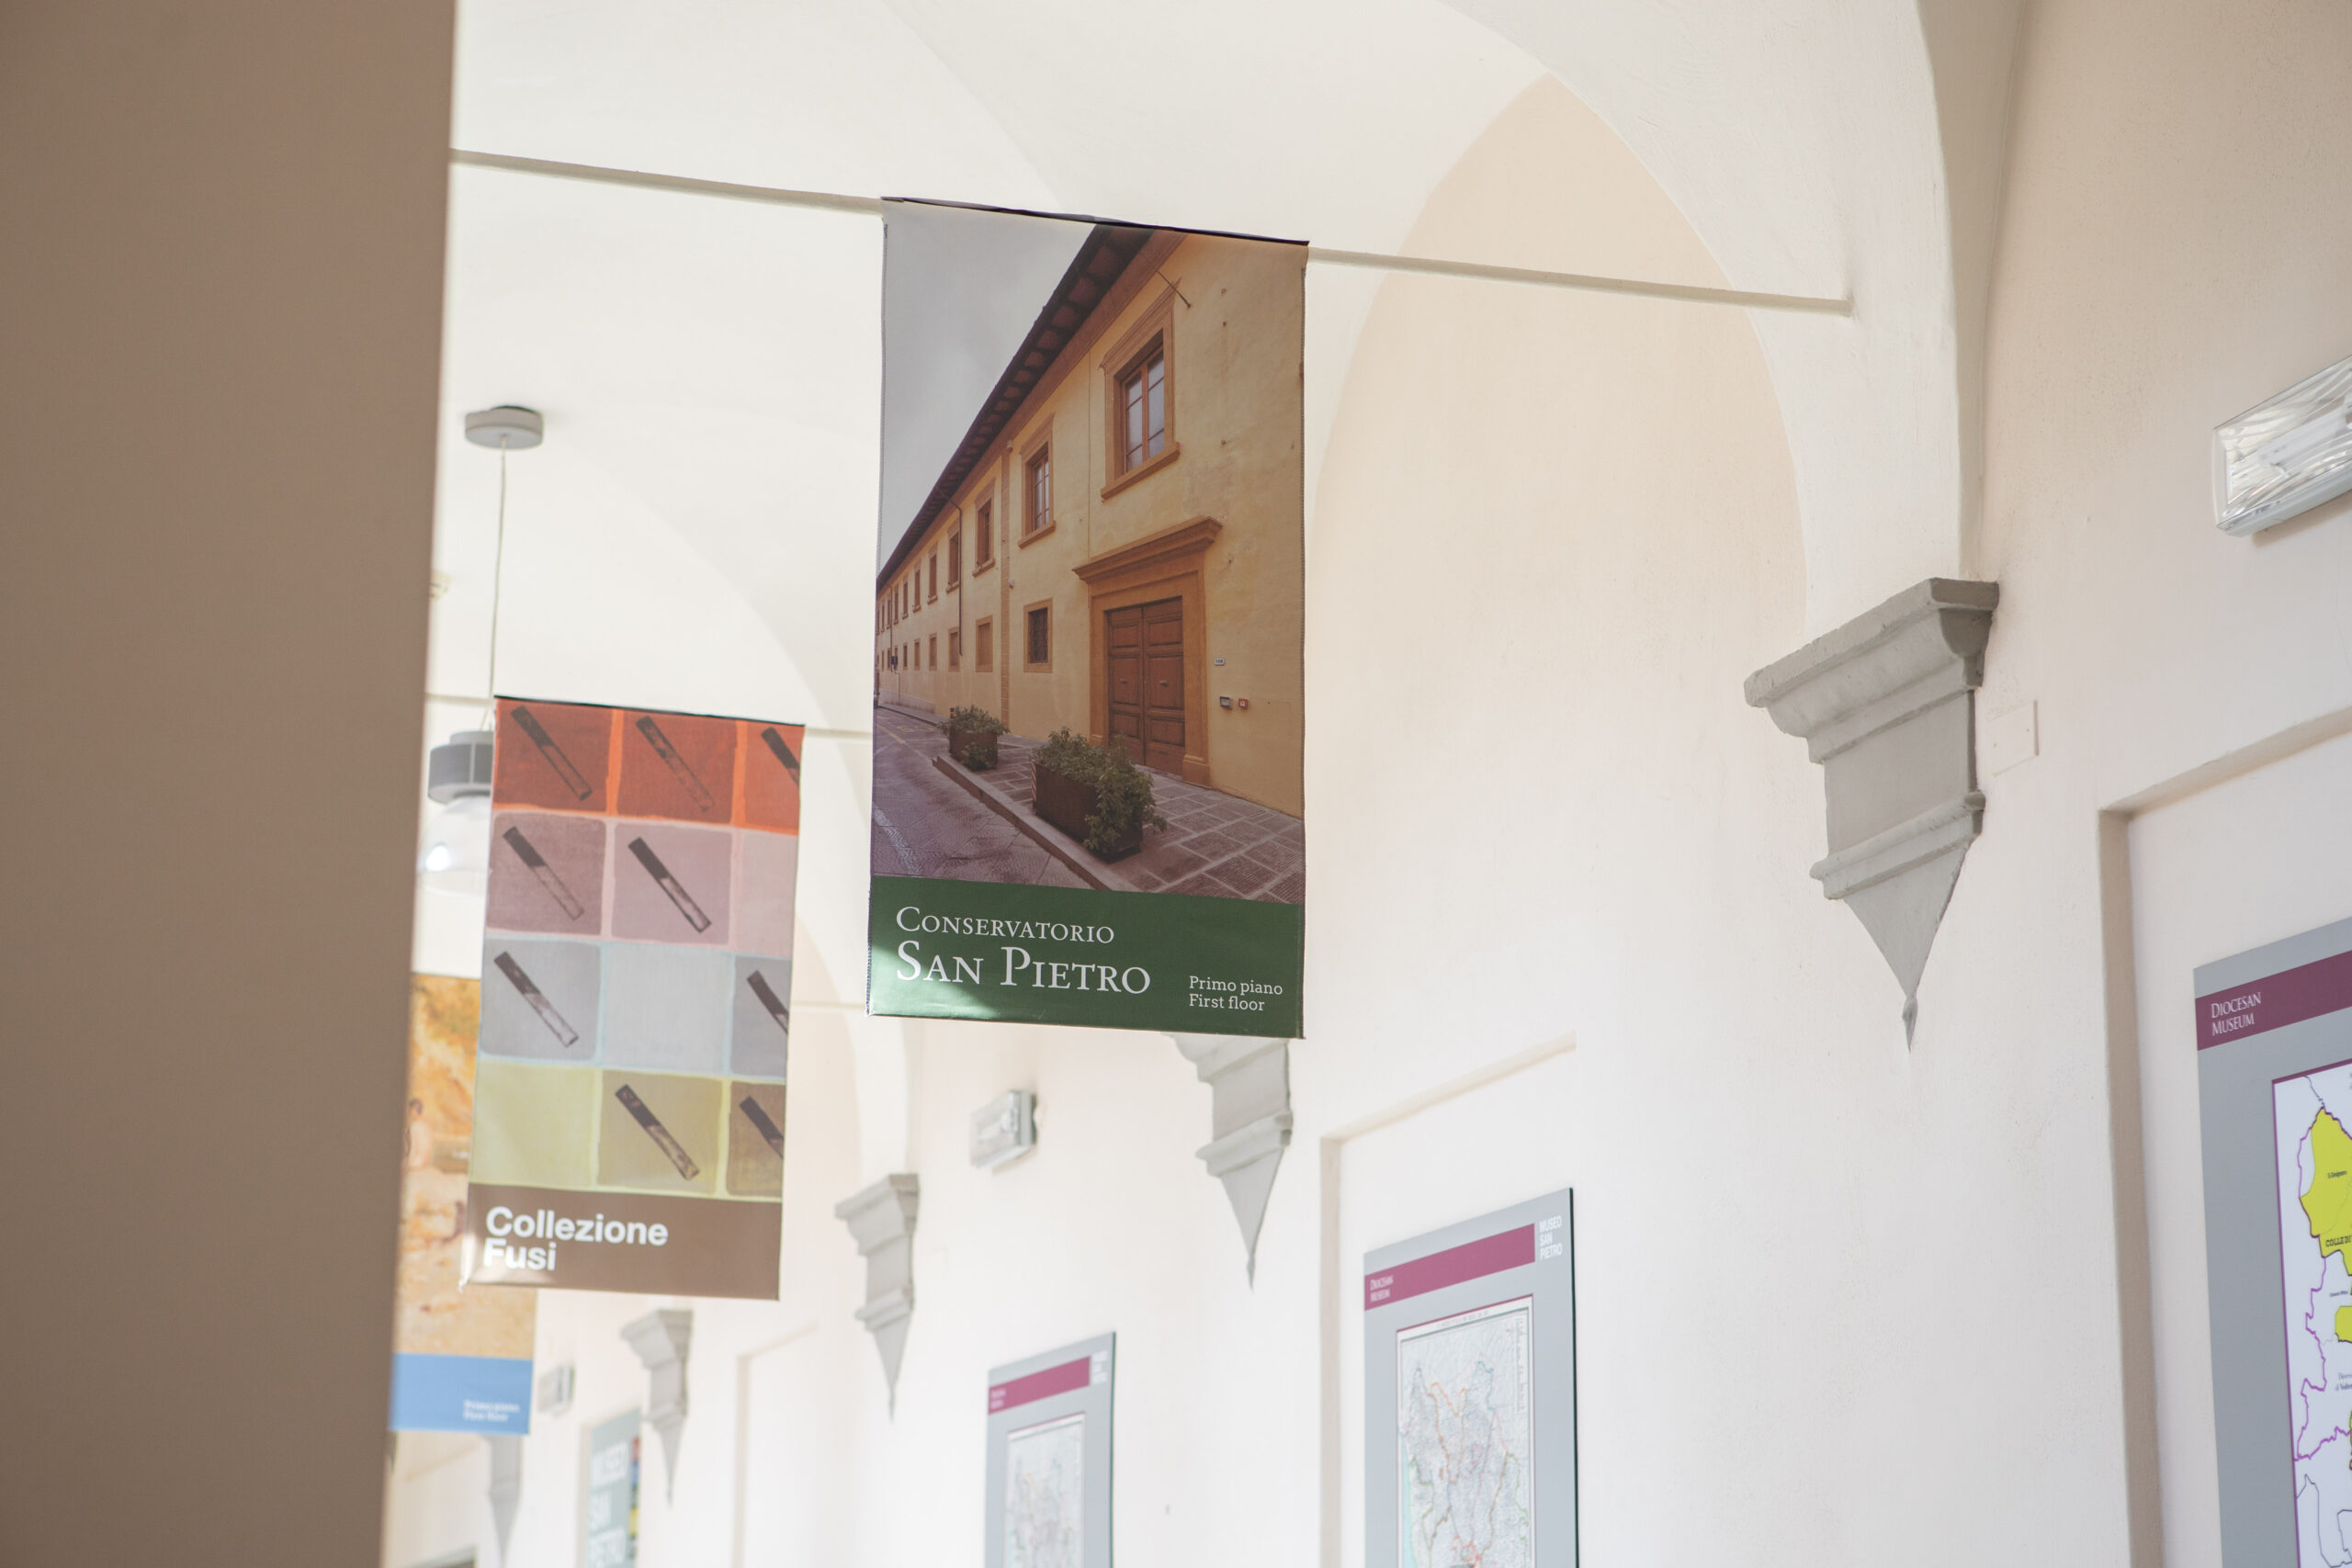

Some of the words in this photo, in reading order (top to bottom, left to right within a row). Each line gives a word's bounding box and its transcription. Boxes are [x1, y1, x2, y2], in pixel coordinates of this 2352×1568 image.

[896, 906, 1114, 943] CONSERVATORIO
[897, 940, 984, 985] SAN
[1000, 946, 1150, 994] PIETRO
[1189, 976, 1237, 992] Primo
[1240, 979, 1283, 996] piano
[1189, 993, 1225, 1009] First
[1228, 996, 1265, 1011] floor
[2211, 991, 2262, 1019] DIOCESAN
[2211, 1013, 2256, 1036] MUSEUM
[486, 1205, 669, 1247] Collezione
[483, 1237, 557, 1271] Fusi
